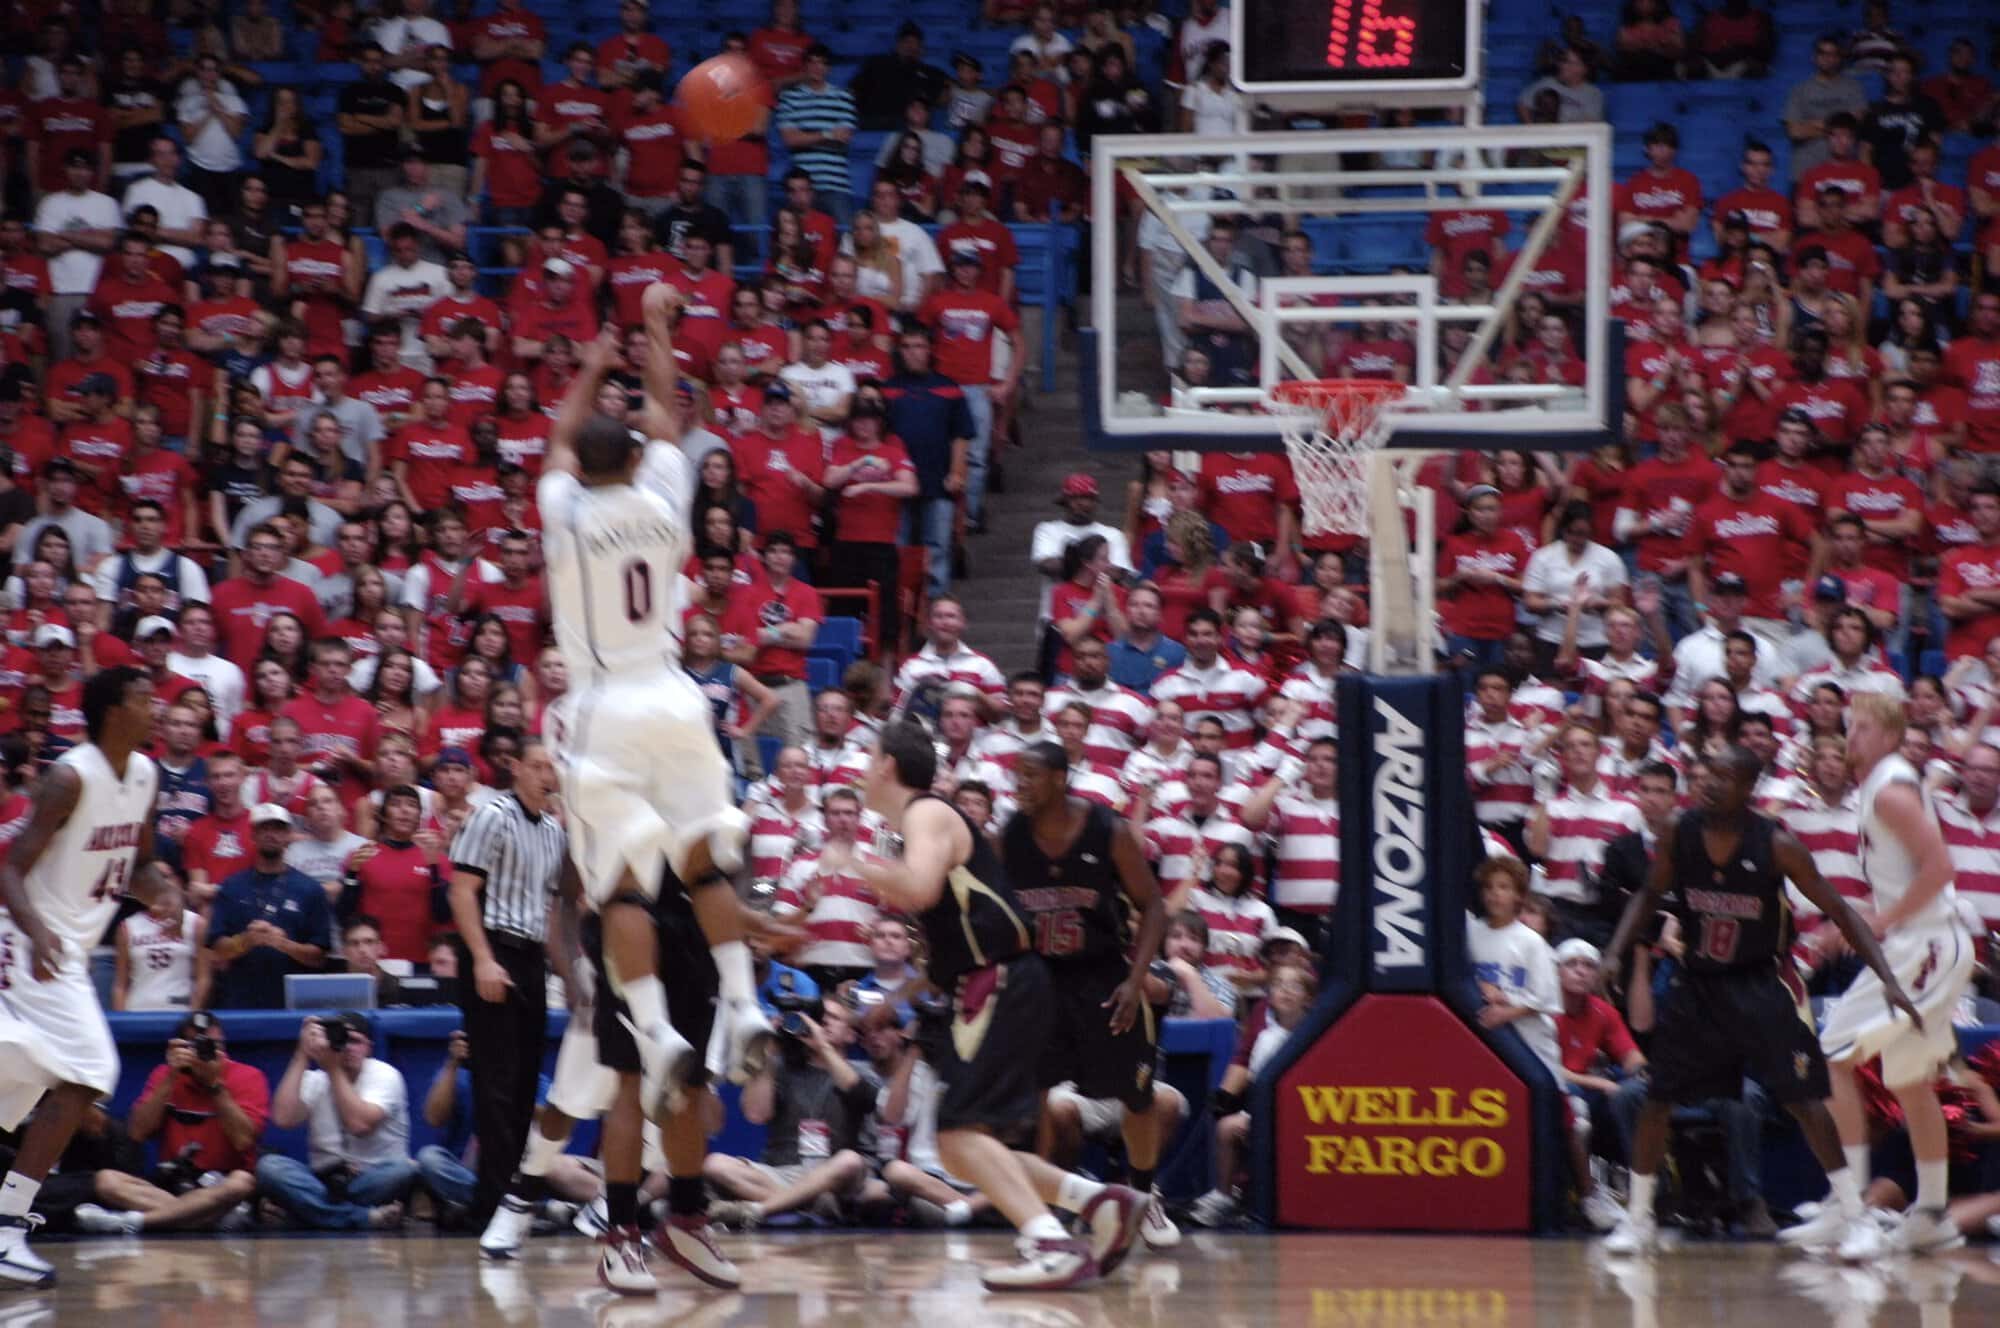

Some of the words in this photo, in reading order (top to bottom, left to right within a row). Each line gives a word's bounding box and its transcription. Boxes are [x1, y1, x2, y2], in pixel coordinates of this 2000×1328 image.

[1327, 0, 1416, 67] 16
[624, 557, 652, 624] 0
[1373, 695, 1425, 967] ARIZONA
[1034, 910, 1086, 955] 15
[1297, 1085, 1509, 1128] WELLS
[1304, 1135, 1507, 1177] FARGO
